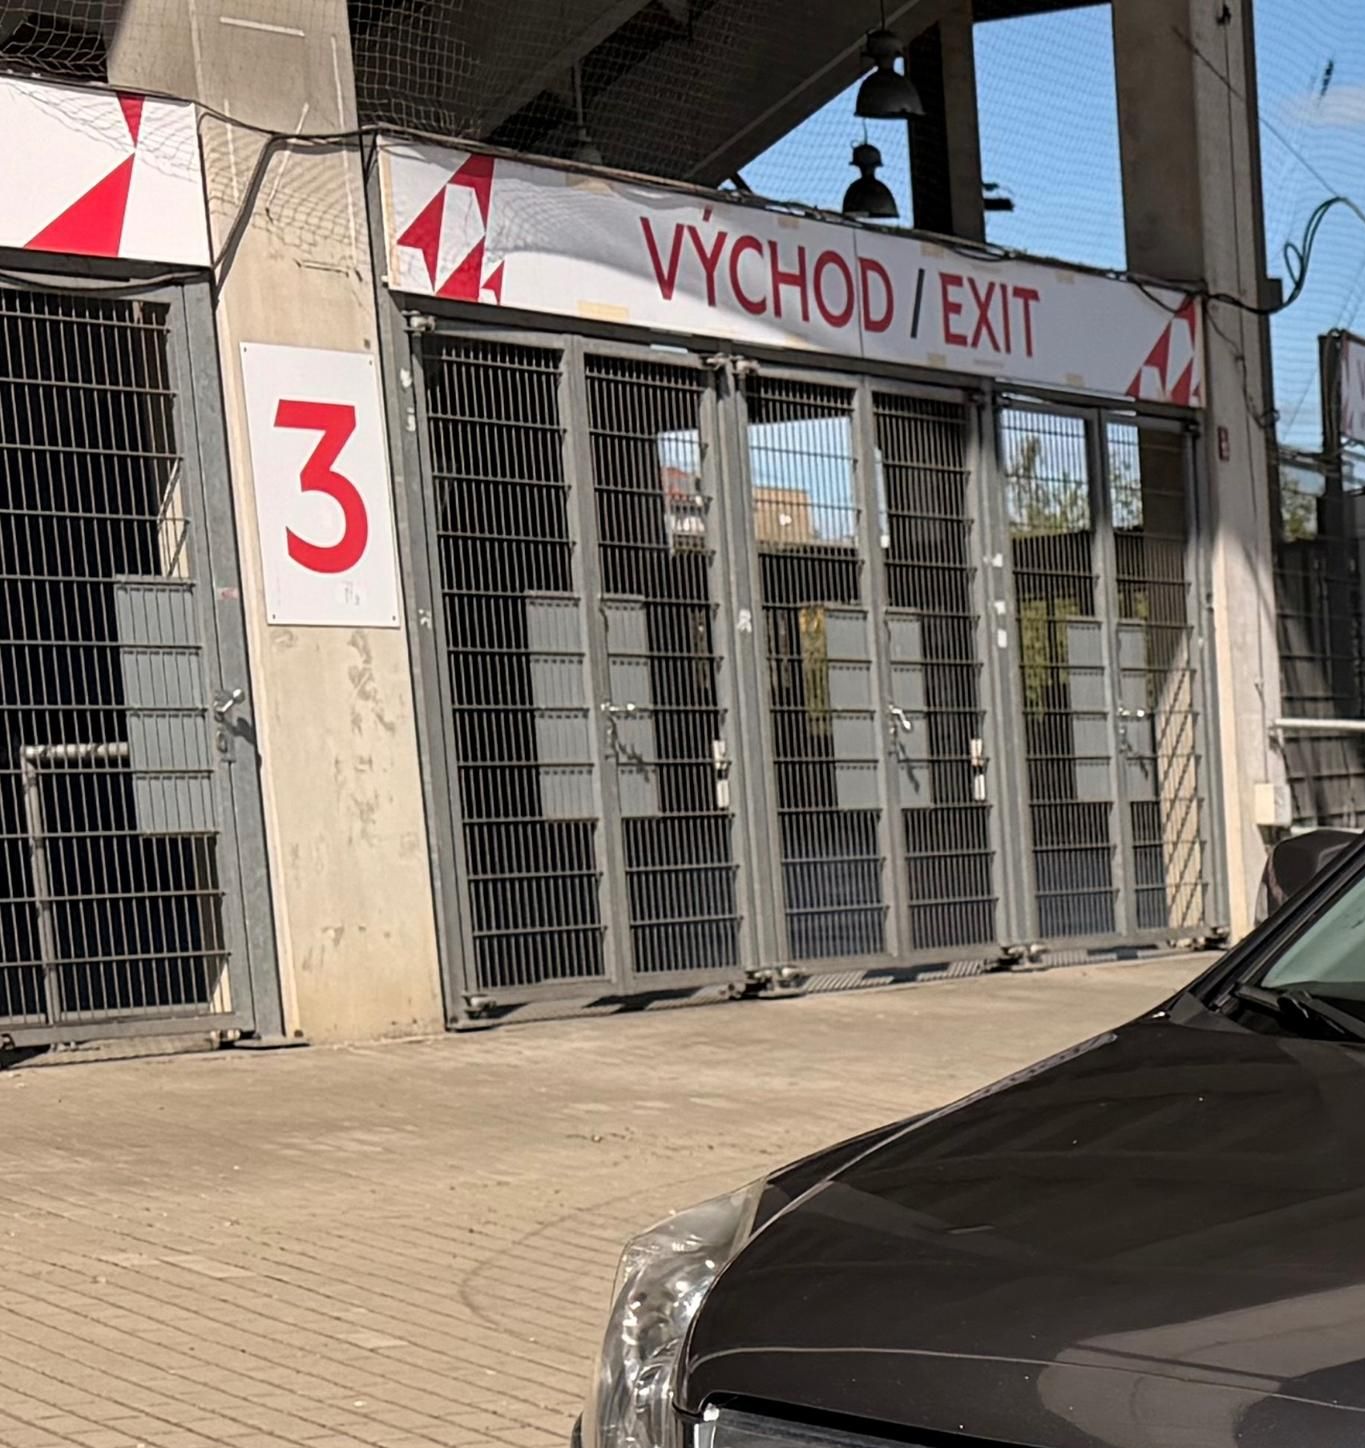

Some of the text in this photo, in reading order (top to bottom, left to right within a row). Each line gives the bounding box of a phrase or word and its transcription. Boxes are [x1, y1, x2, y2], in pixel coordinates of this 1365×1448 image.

[640, 207, 895, 334] VÝCHOD
[937, 272, 1041, 358] EXIT
[273, 398, 369, 574] 3
